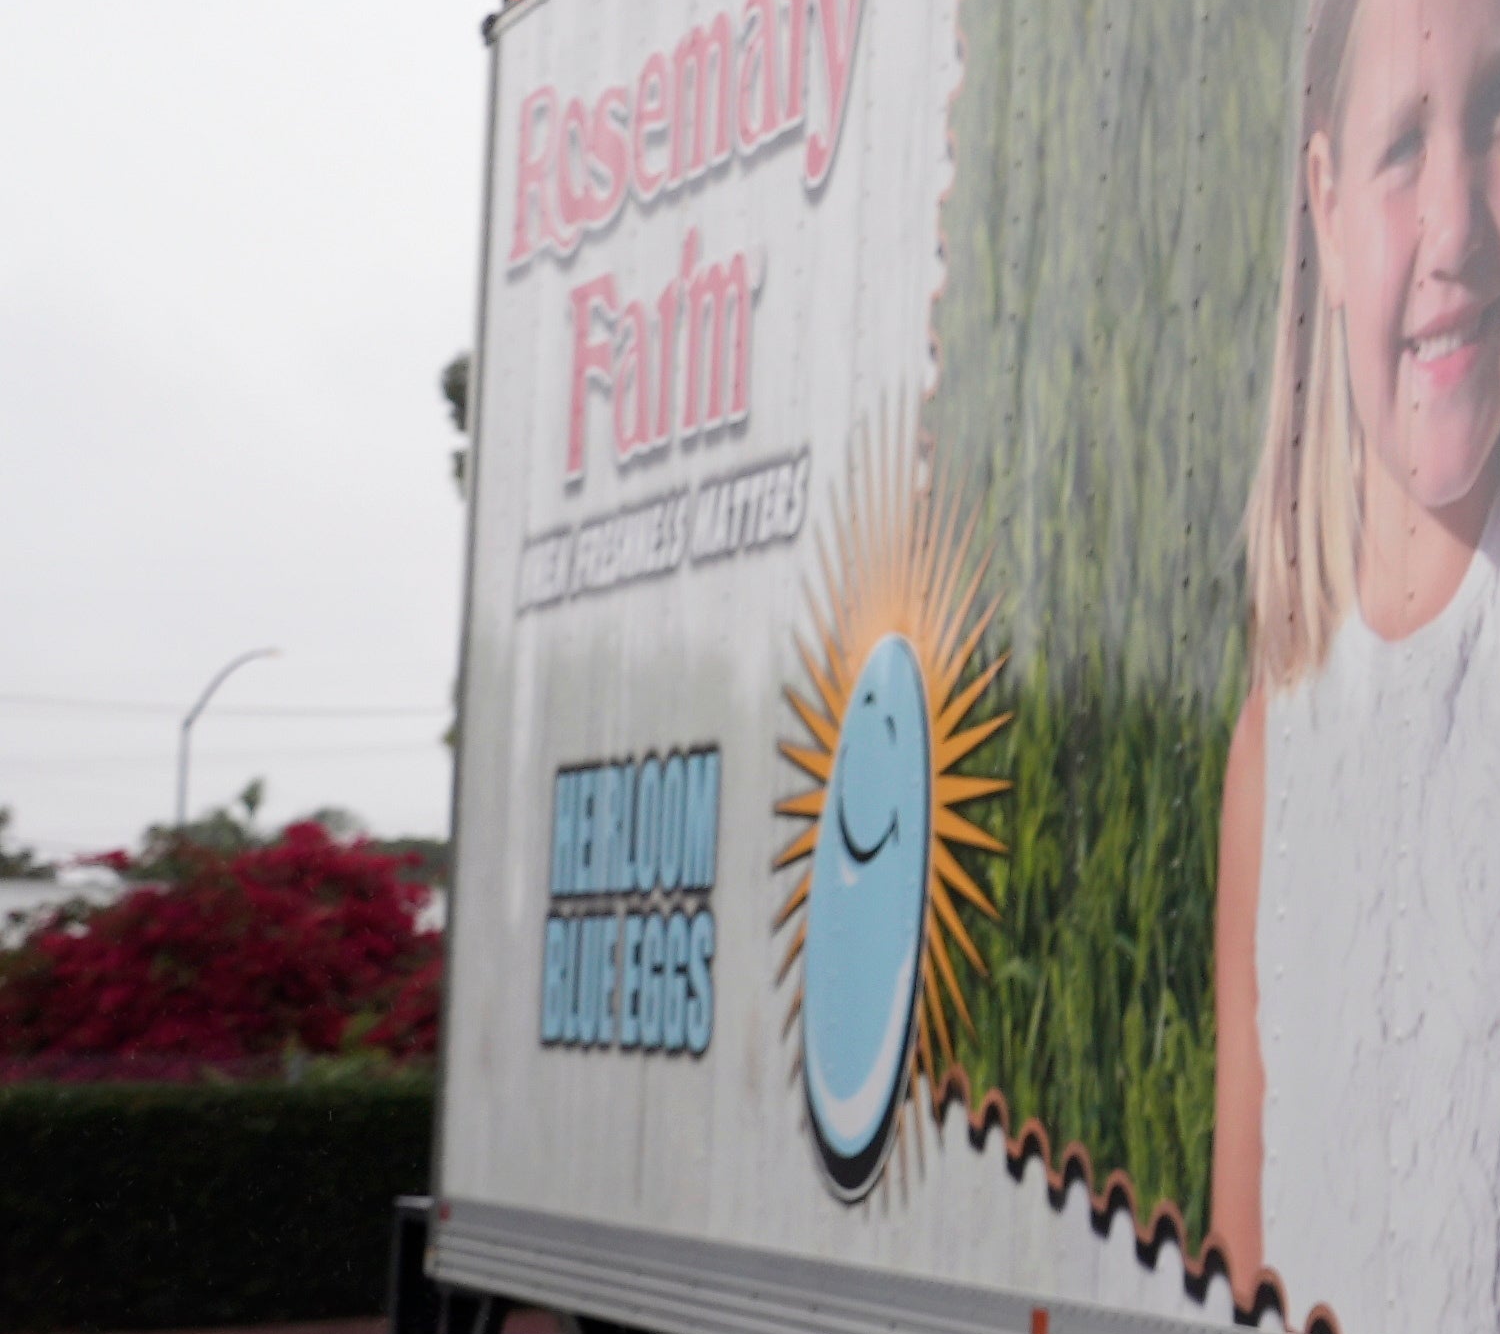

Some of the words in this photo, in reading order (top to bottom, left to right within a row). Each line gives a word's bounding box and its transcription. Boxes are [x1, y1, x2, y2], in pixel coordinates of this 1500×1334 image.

[565, 225, 753, 479] Farm
[540, 907, 618, 1052] BLUE
[619, 903, 716, 1057] EGGS
